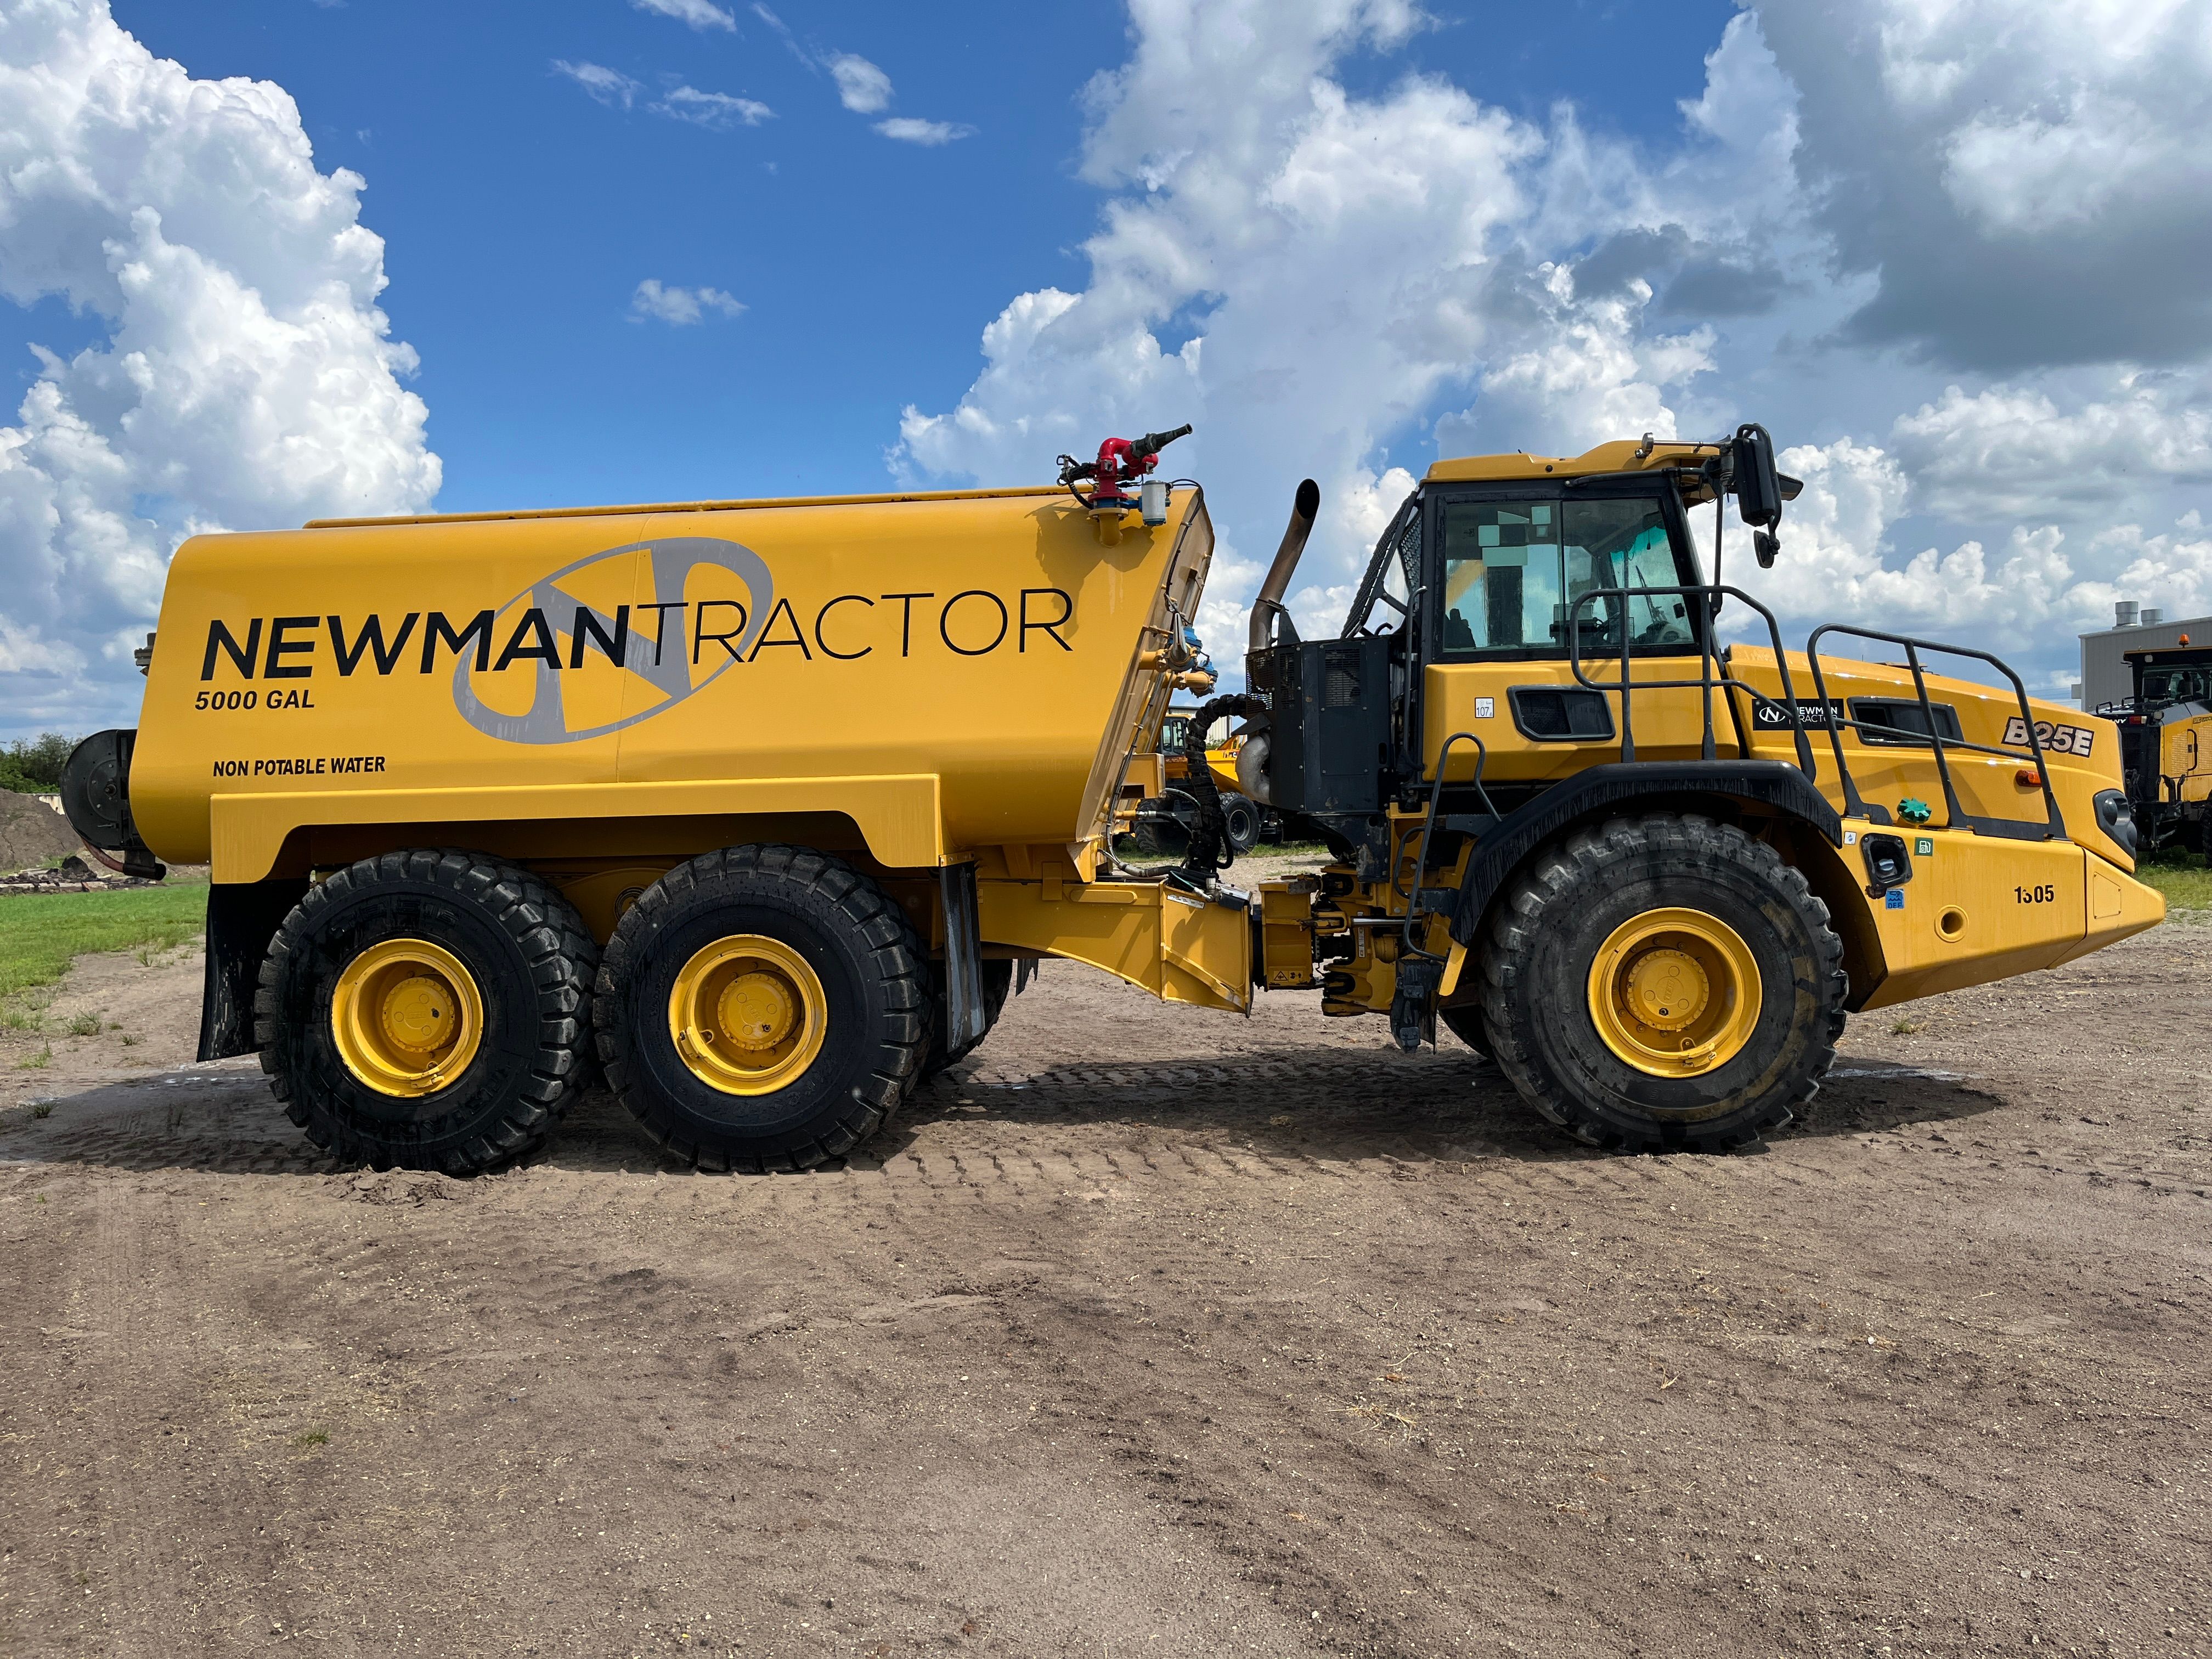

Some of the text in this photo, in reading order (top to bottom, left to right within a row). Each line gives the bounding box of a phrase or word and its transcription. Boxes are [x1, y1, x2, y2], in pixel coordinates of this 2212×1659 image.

[195, 689, 315, 710] 5000 GAL
[1476, 707, 1489, 716] 107
[2001, 716, 2095, 758] B25E
[213, 756, 386, 776] NON POTABLE WATER
